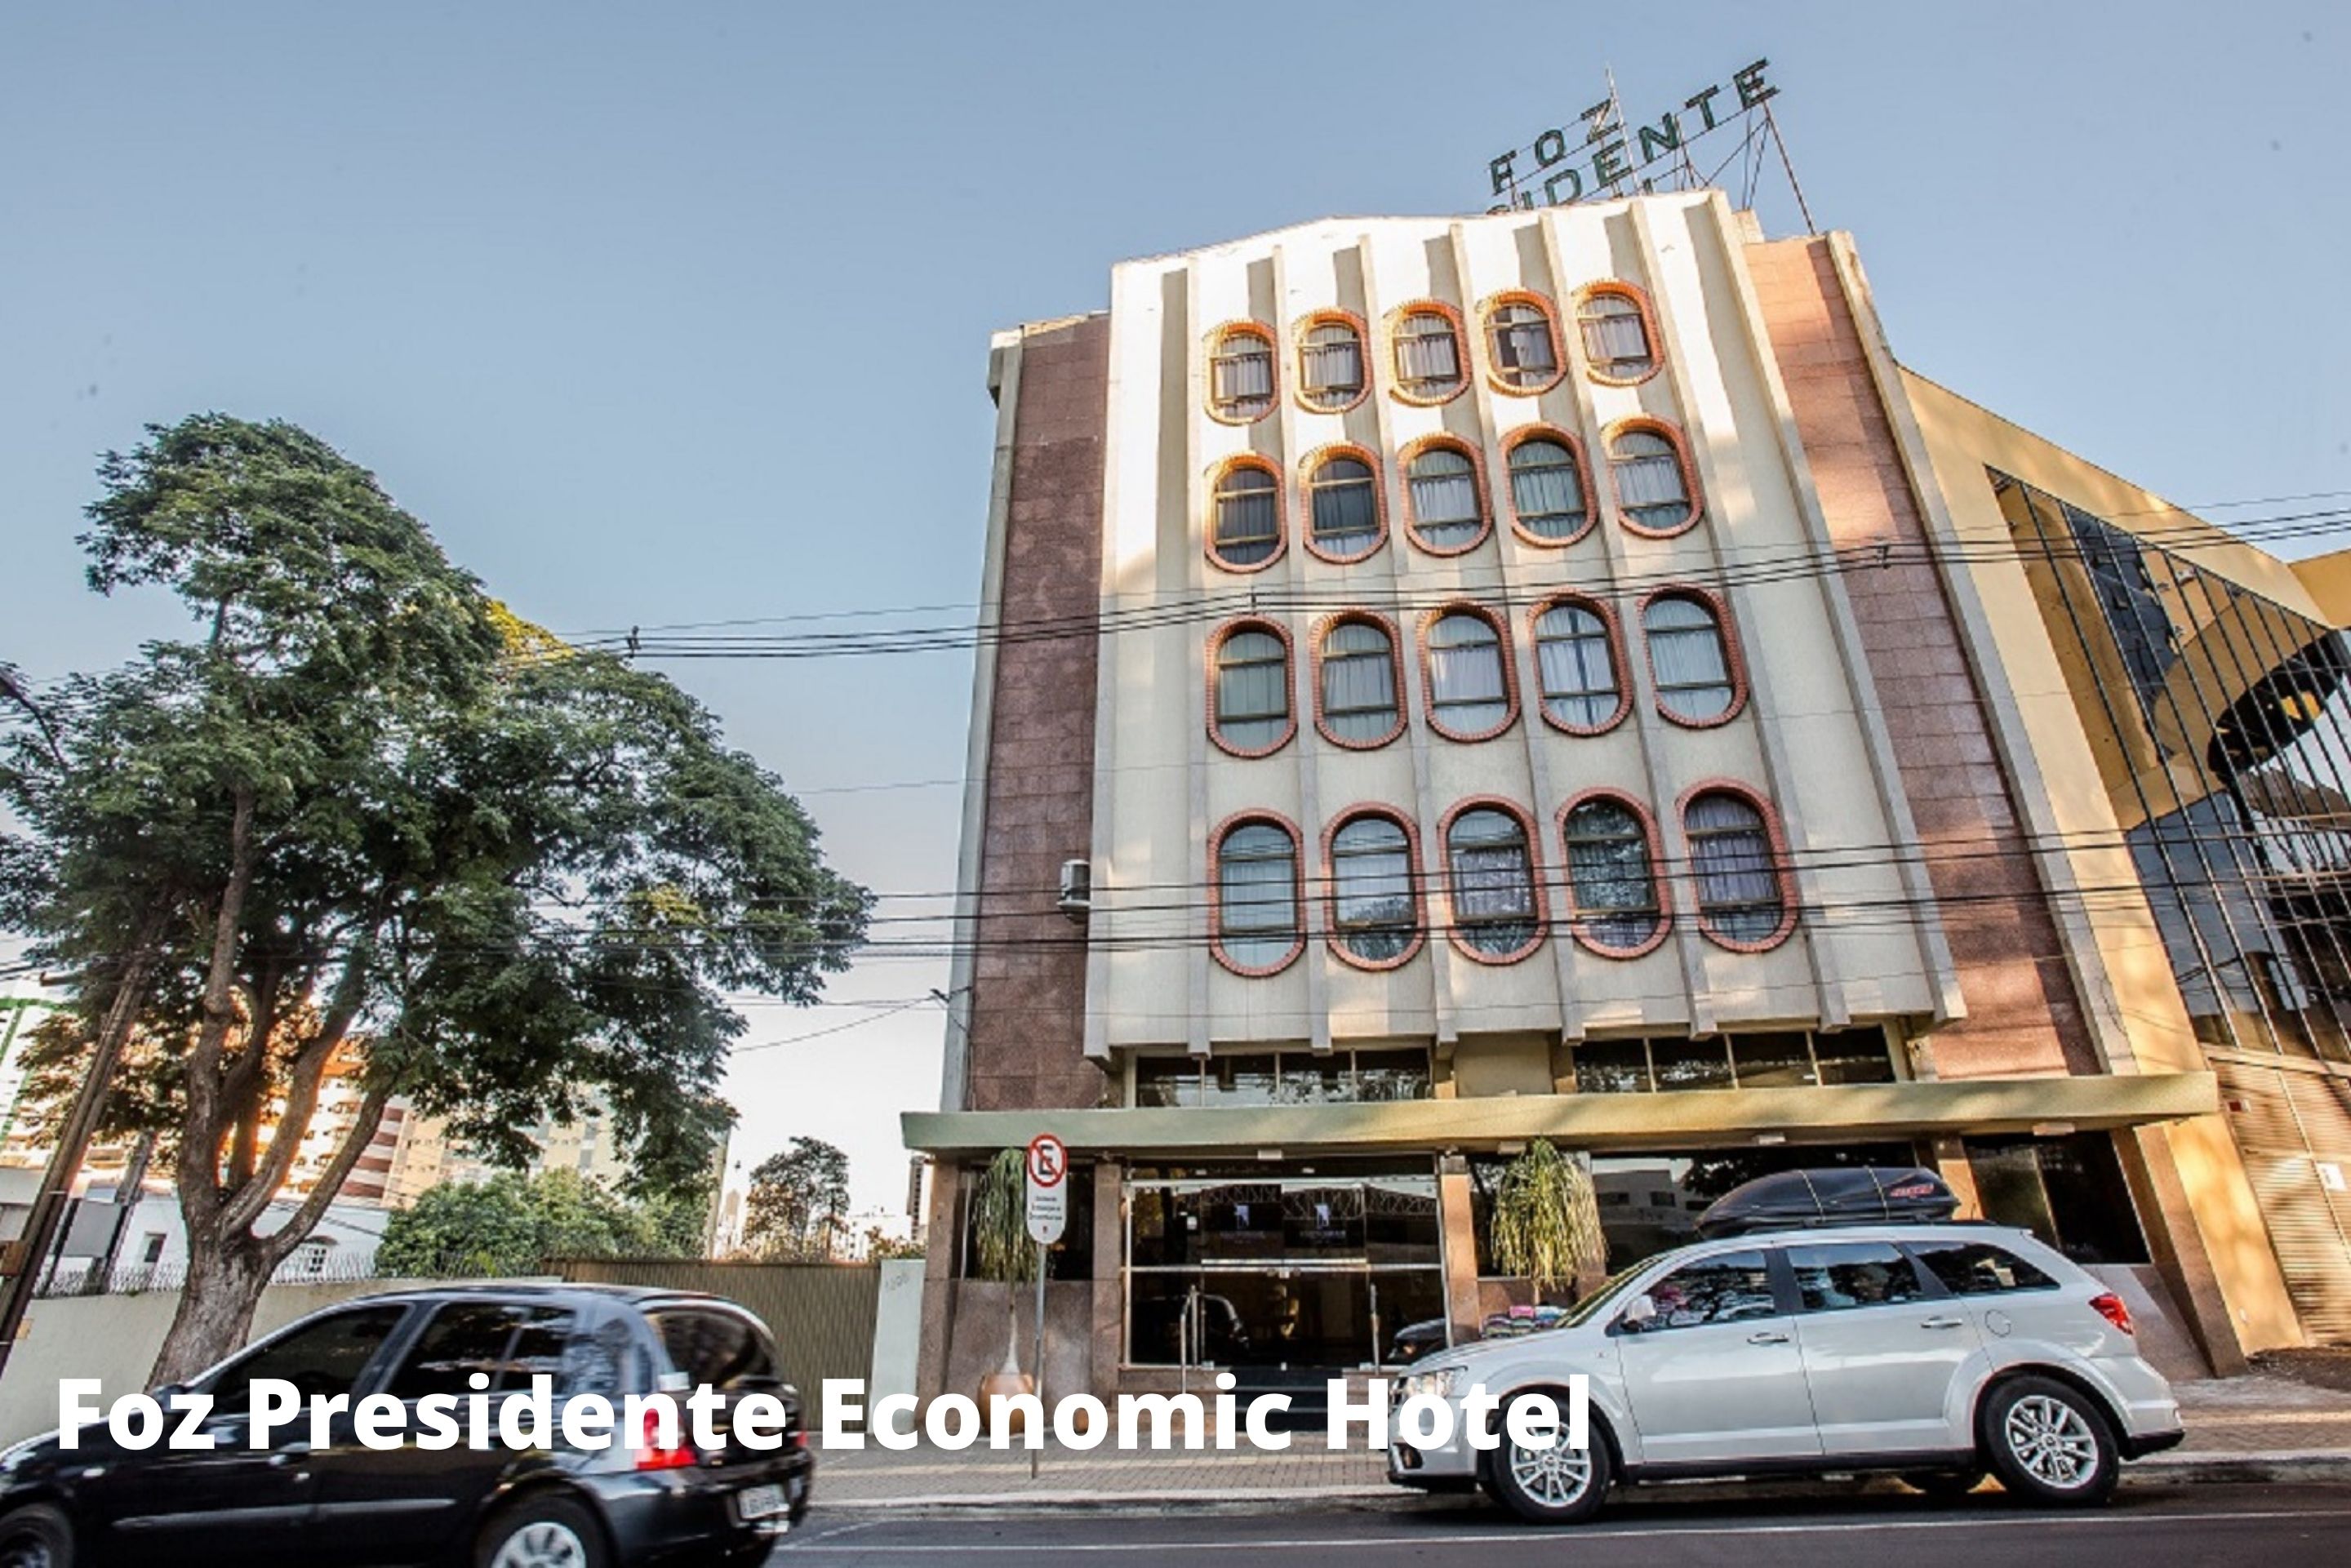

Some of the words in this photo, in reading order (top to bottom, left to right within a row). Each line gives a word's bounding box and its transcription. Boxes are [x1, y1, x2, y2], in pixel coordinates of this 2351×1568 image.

[1487, 57, 1780, 214] IDENTE
[1489, 97, 1620, 195] FOZ
[1038, 1144, 1053, 1175] E
